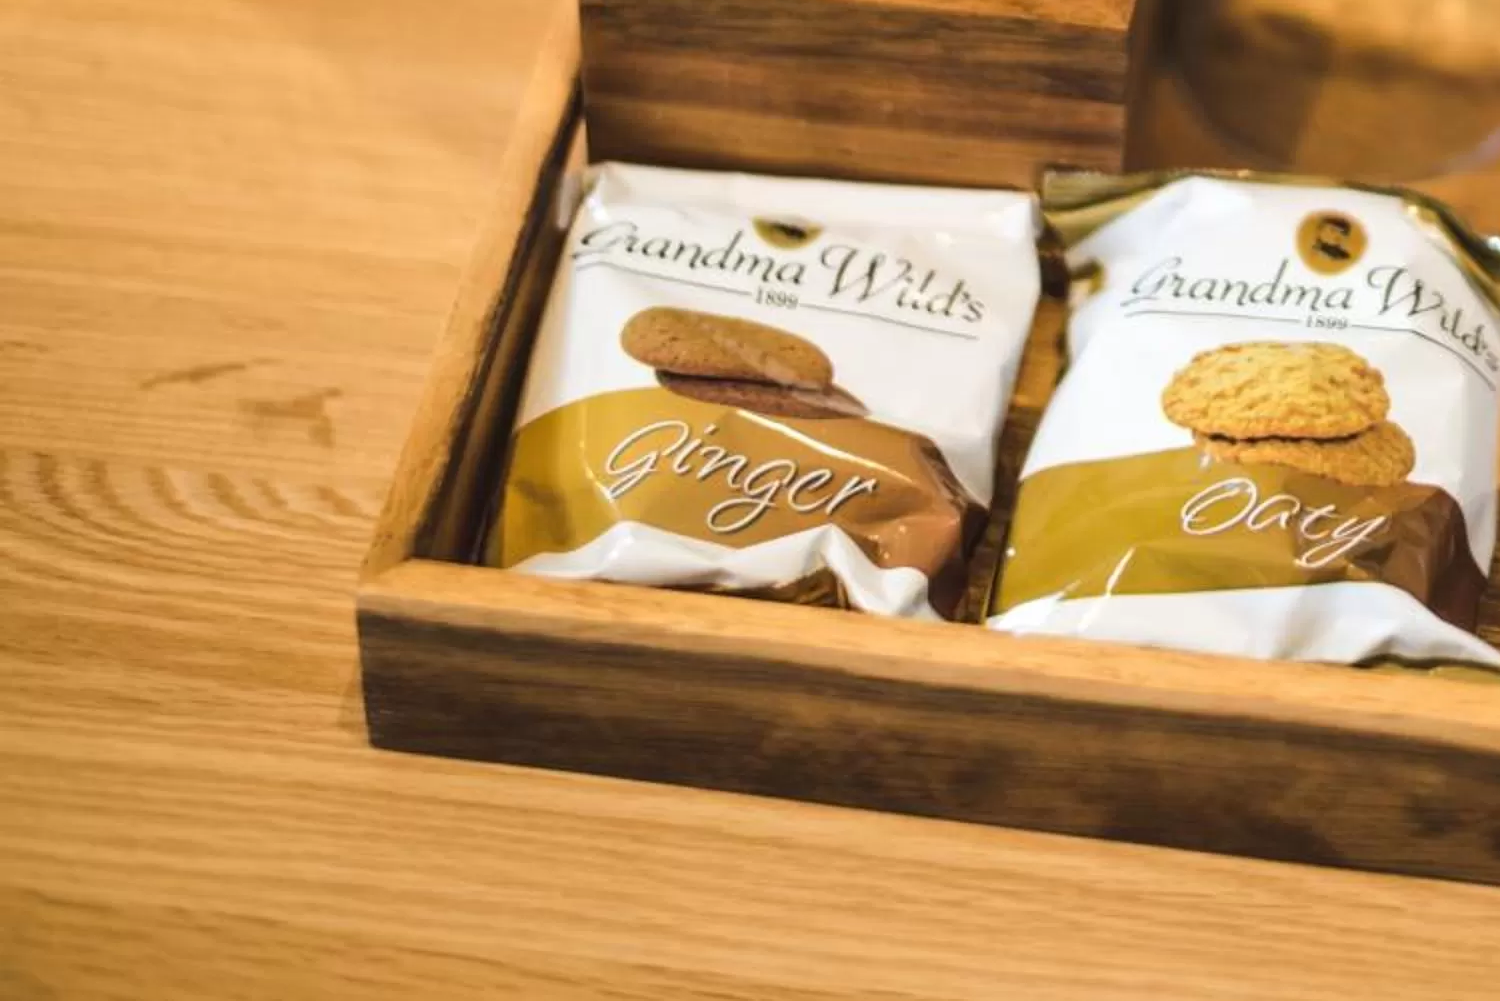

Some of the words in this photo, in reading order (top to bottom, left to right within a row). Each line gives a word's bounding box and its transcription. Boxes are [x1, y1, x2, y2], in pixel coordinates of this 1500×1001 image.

[572, 221, 806, 286] Grandma
[755, 285, 799, 310] 1899
[1120, 257, 1353, 311] Grandma
[1305, 314, 1349, 330] 1899
[605, 420, 880, 534] Ginger
[1181, 477, 1388, 568] Oaty
